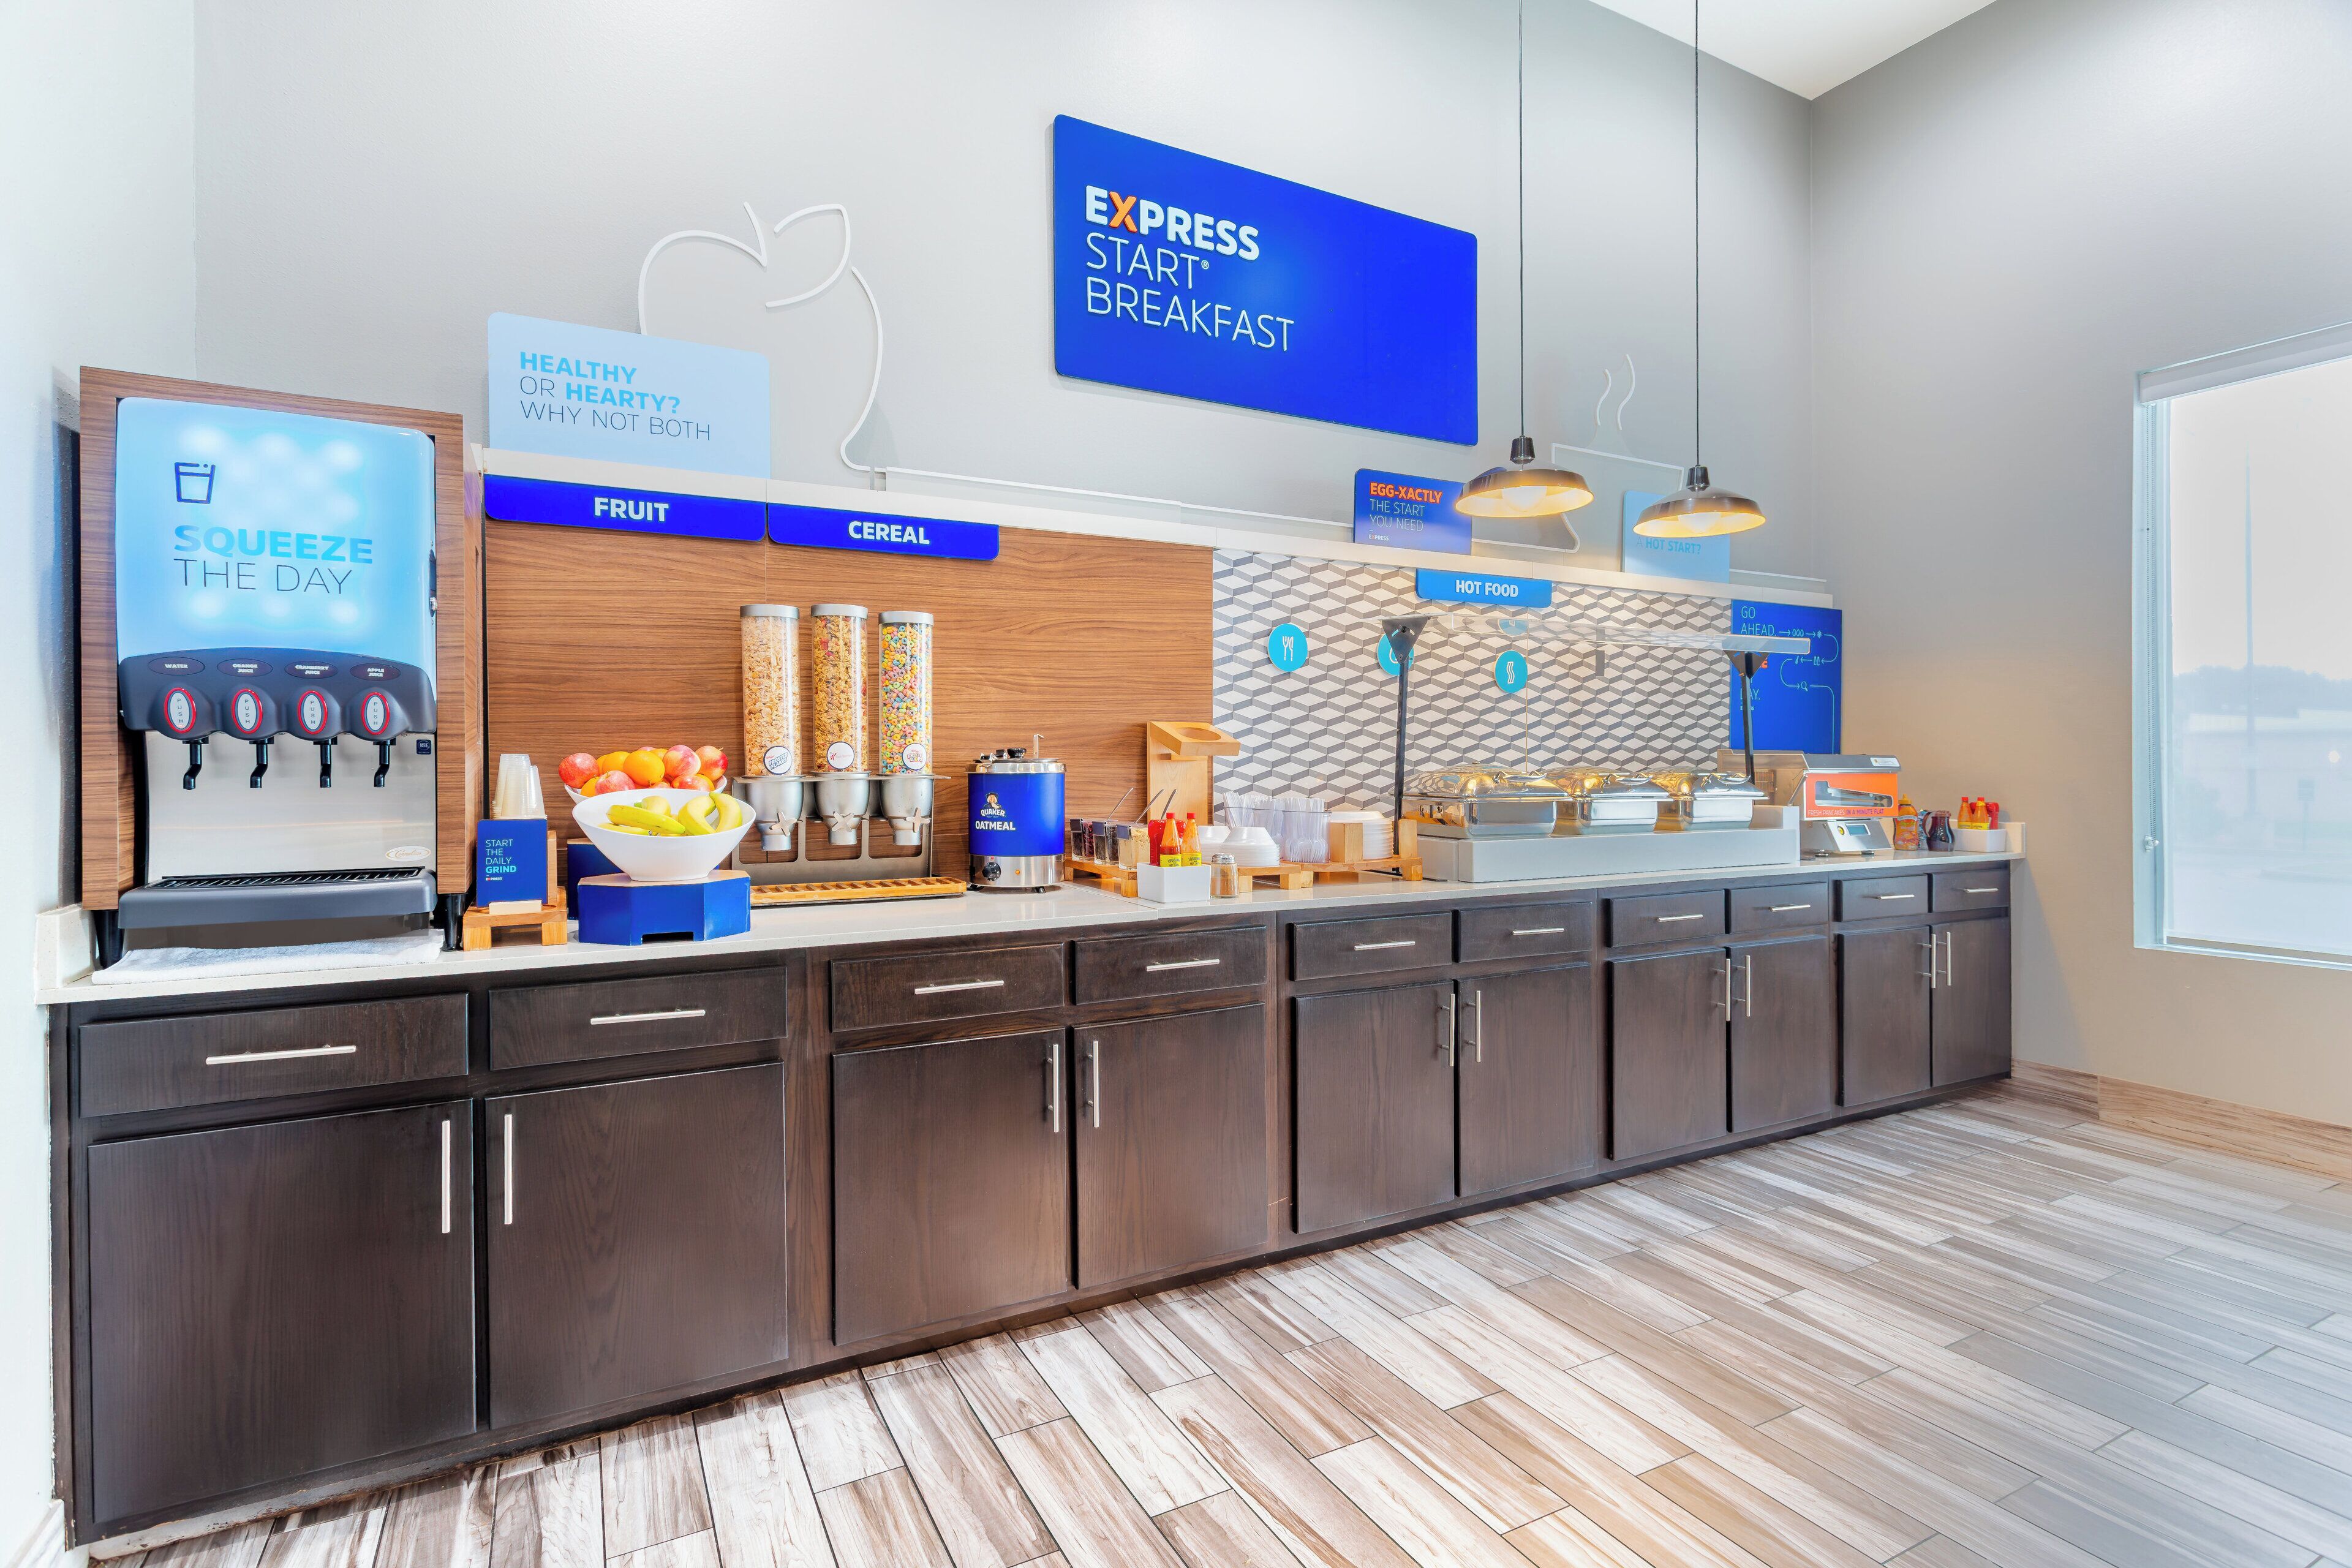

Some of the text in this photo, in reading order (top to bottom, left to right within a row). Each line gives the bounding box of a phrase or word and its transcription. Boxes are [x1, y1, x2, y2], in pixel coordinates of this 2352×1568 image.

[1086, 185, 1259, 261] EXPRESS
[1087, 276, 1294, 352] BREAKFAST
[521, 352, 637, 384] HEALTHY
[520, 376, 680, 413] OR HEARTY?
[521, 400, 710, 440] WHY NOT BOTH
[1370, 481, 1442, 503] EGG-XACTLY
[594, 497, 669, 522] FRUIT
[1370, 499, 1425, 516] THE START
[848, 521, 930, 545] CEREAL
[1370, 514, 1423, 531] YOU NEED
[174, 524, 372, 564] SQUEEZE
[1646, 538, 1664, 550] HOT
[1668, 540, 1702, 554] START?
[174, 558, 353, 595] THE DAY
[1455, 579, 1518, 597] HOT FOOD
[1741, 606, 1755, 619] GO
[981, 809, 1005, 817] QUAKER
[975, 820, 1016, 831] OATMEAL
[486, 839, 513, 847] START
